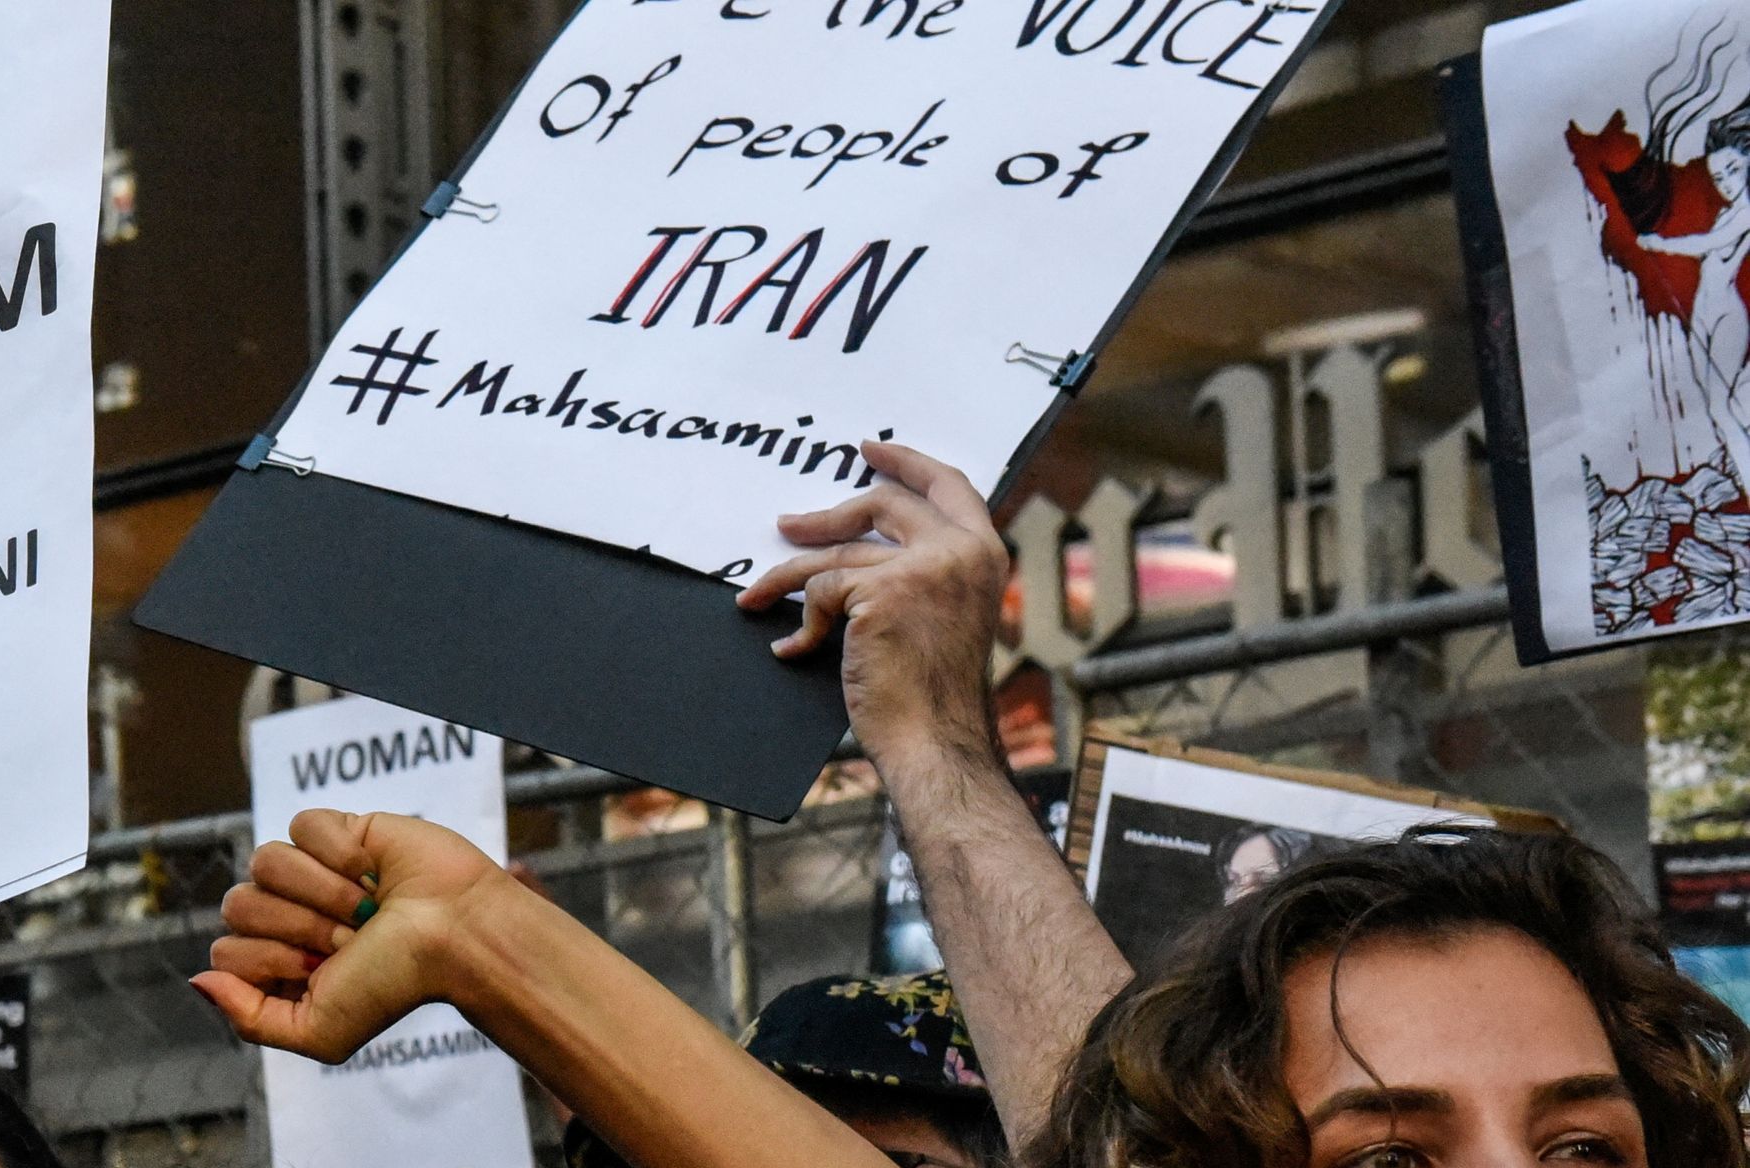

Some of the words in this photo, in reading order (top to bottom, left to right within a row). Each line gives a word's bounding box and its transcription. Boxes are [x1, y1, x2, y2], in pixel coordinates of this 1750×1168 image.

[668, 98, 950, 191] people
[995, 131, 1150, 199] of
[589, 224, 929, 353] IRAN
[291, 723, 475, 791] WOMAN
